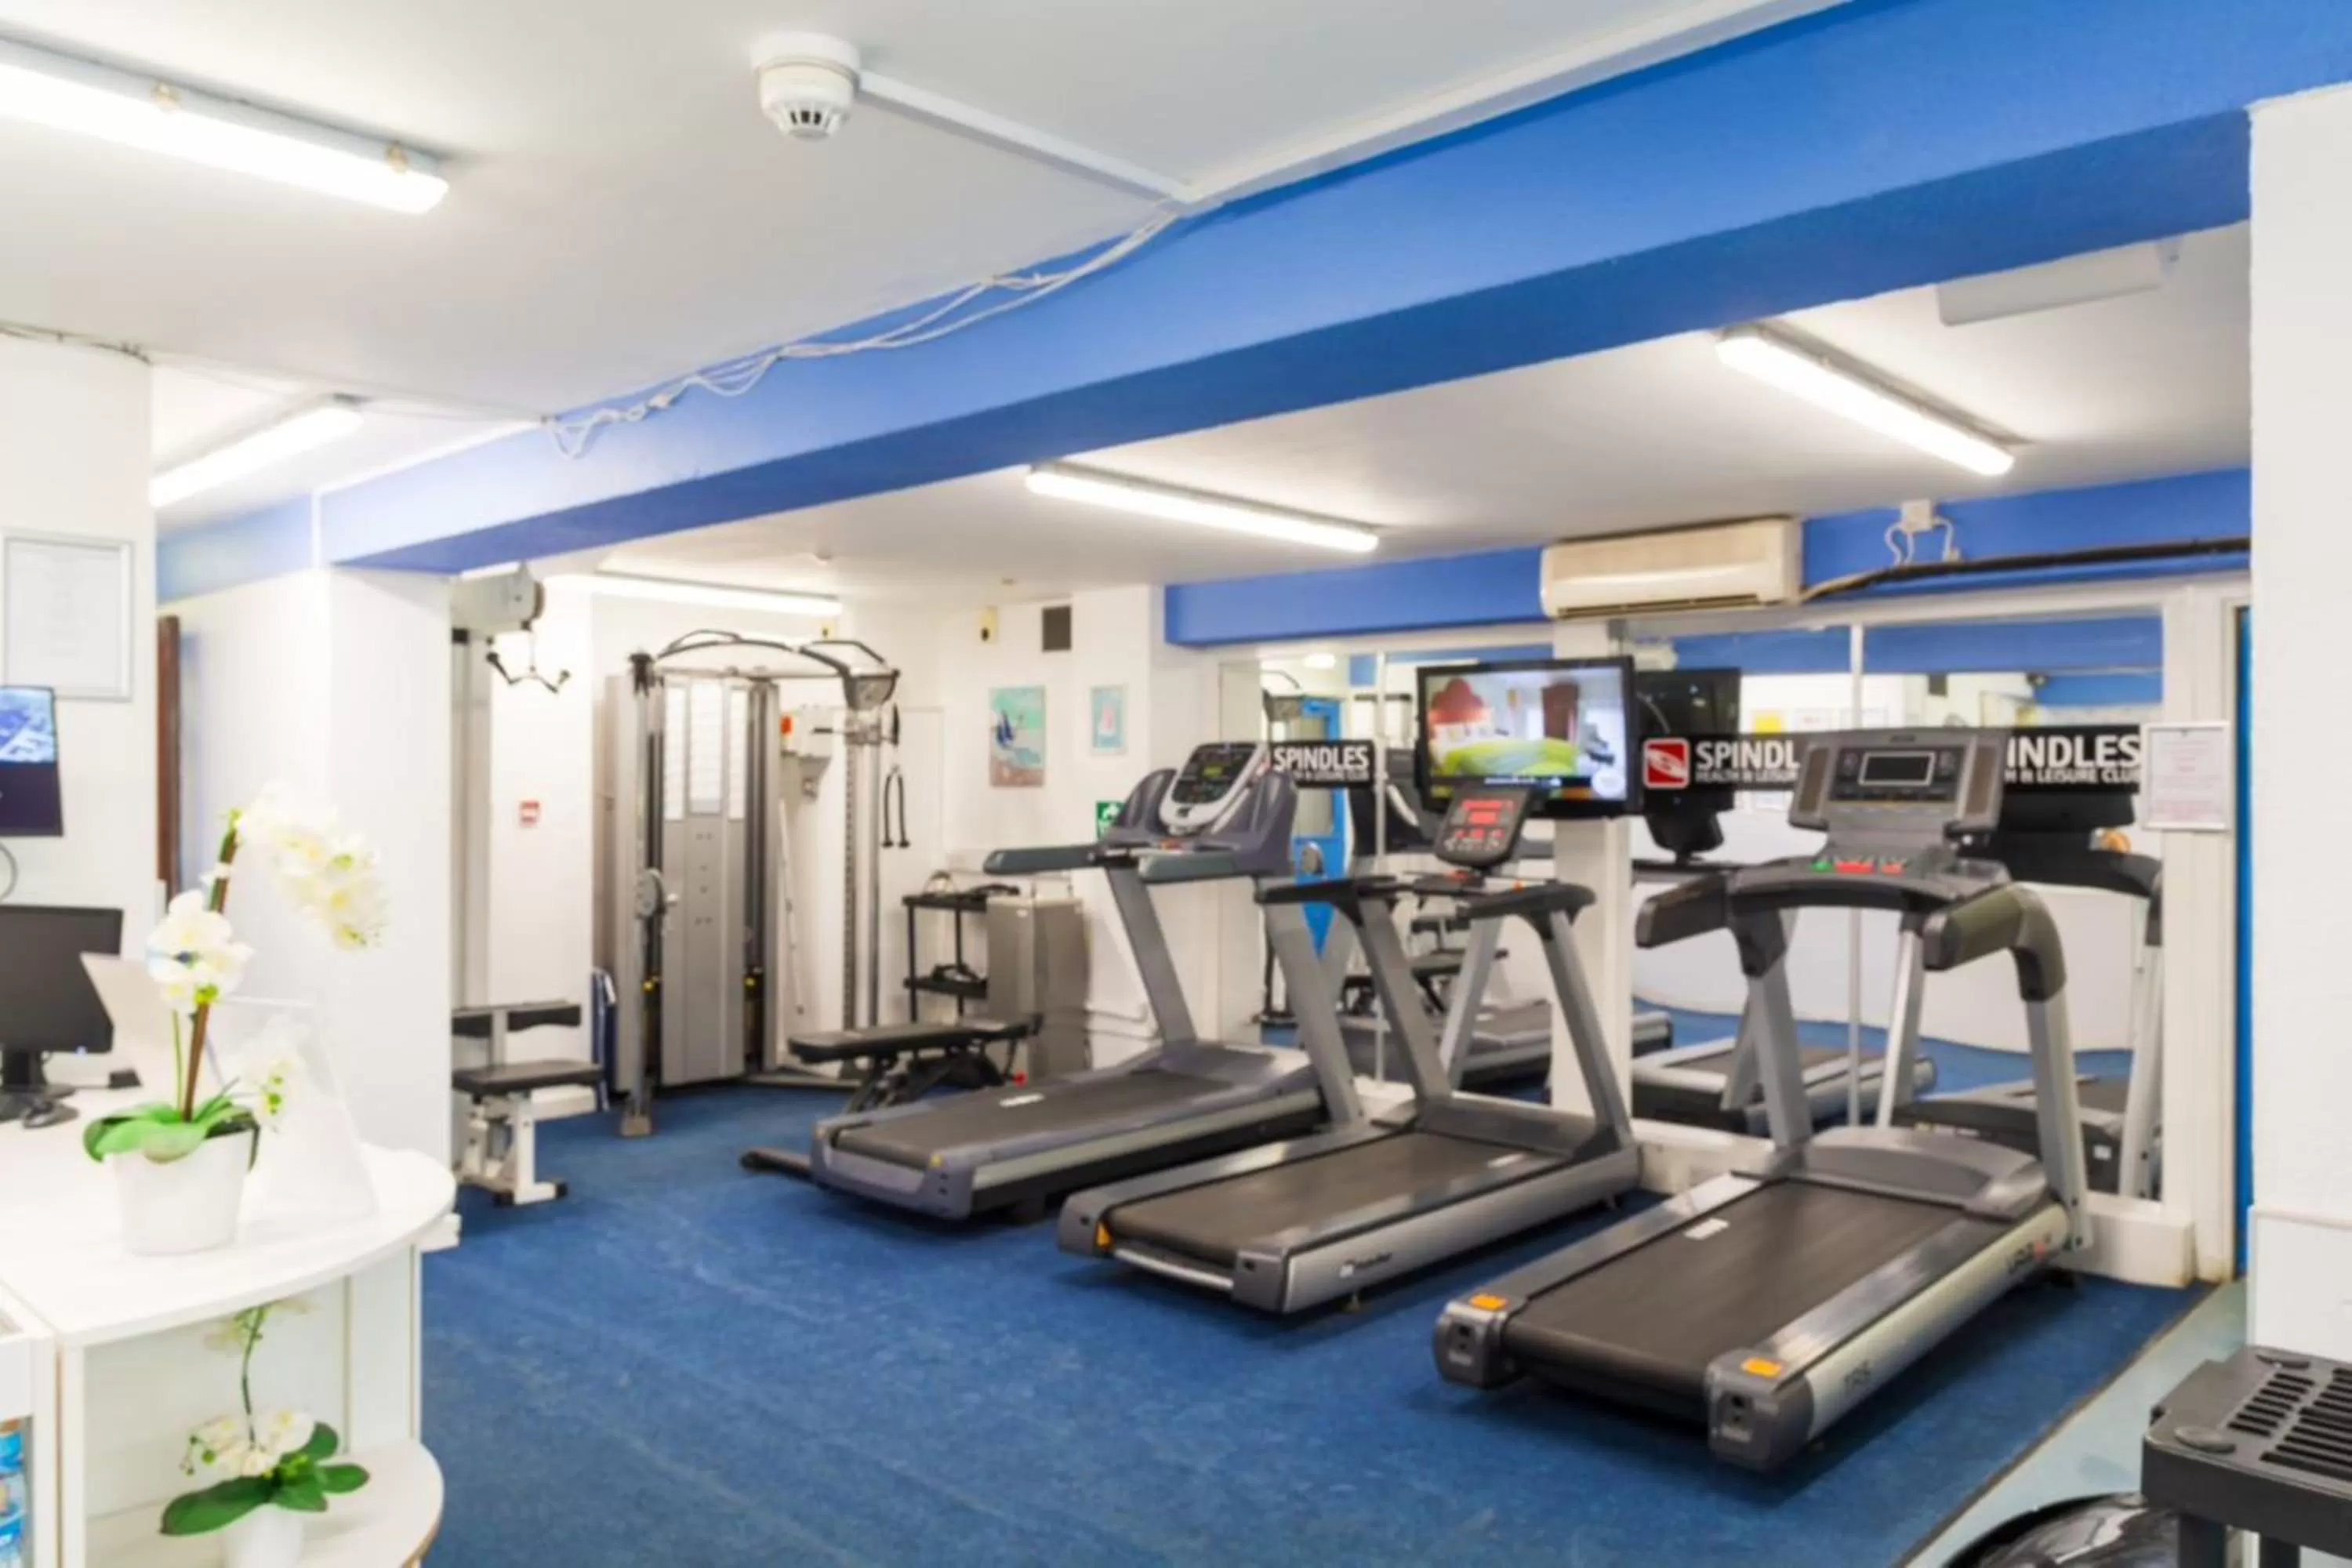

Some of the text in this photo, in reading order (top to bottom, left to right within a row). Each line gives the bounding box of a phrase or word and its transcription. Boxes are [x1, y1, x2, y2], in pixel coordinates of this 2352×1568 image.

[1273, 746, 1369, 771] SPINDLES
[1695, 739, 1801, 769] SPINDL
[2006, 735, 2140, 768] INDLES
